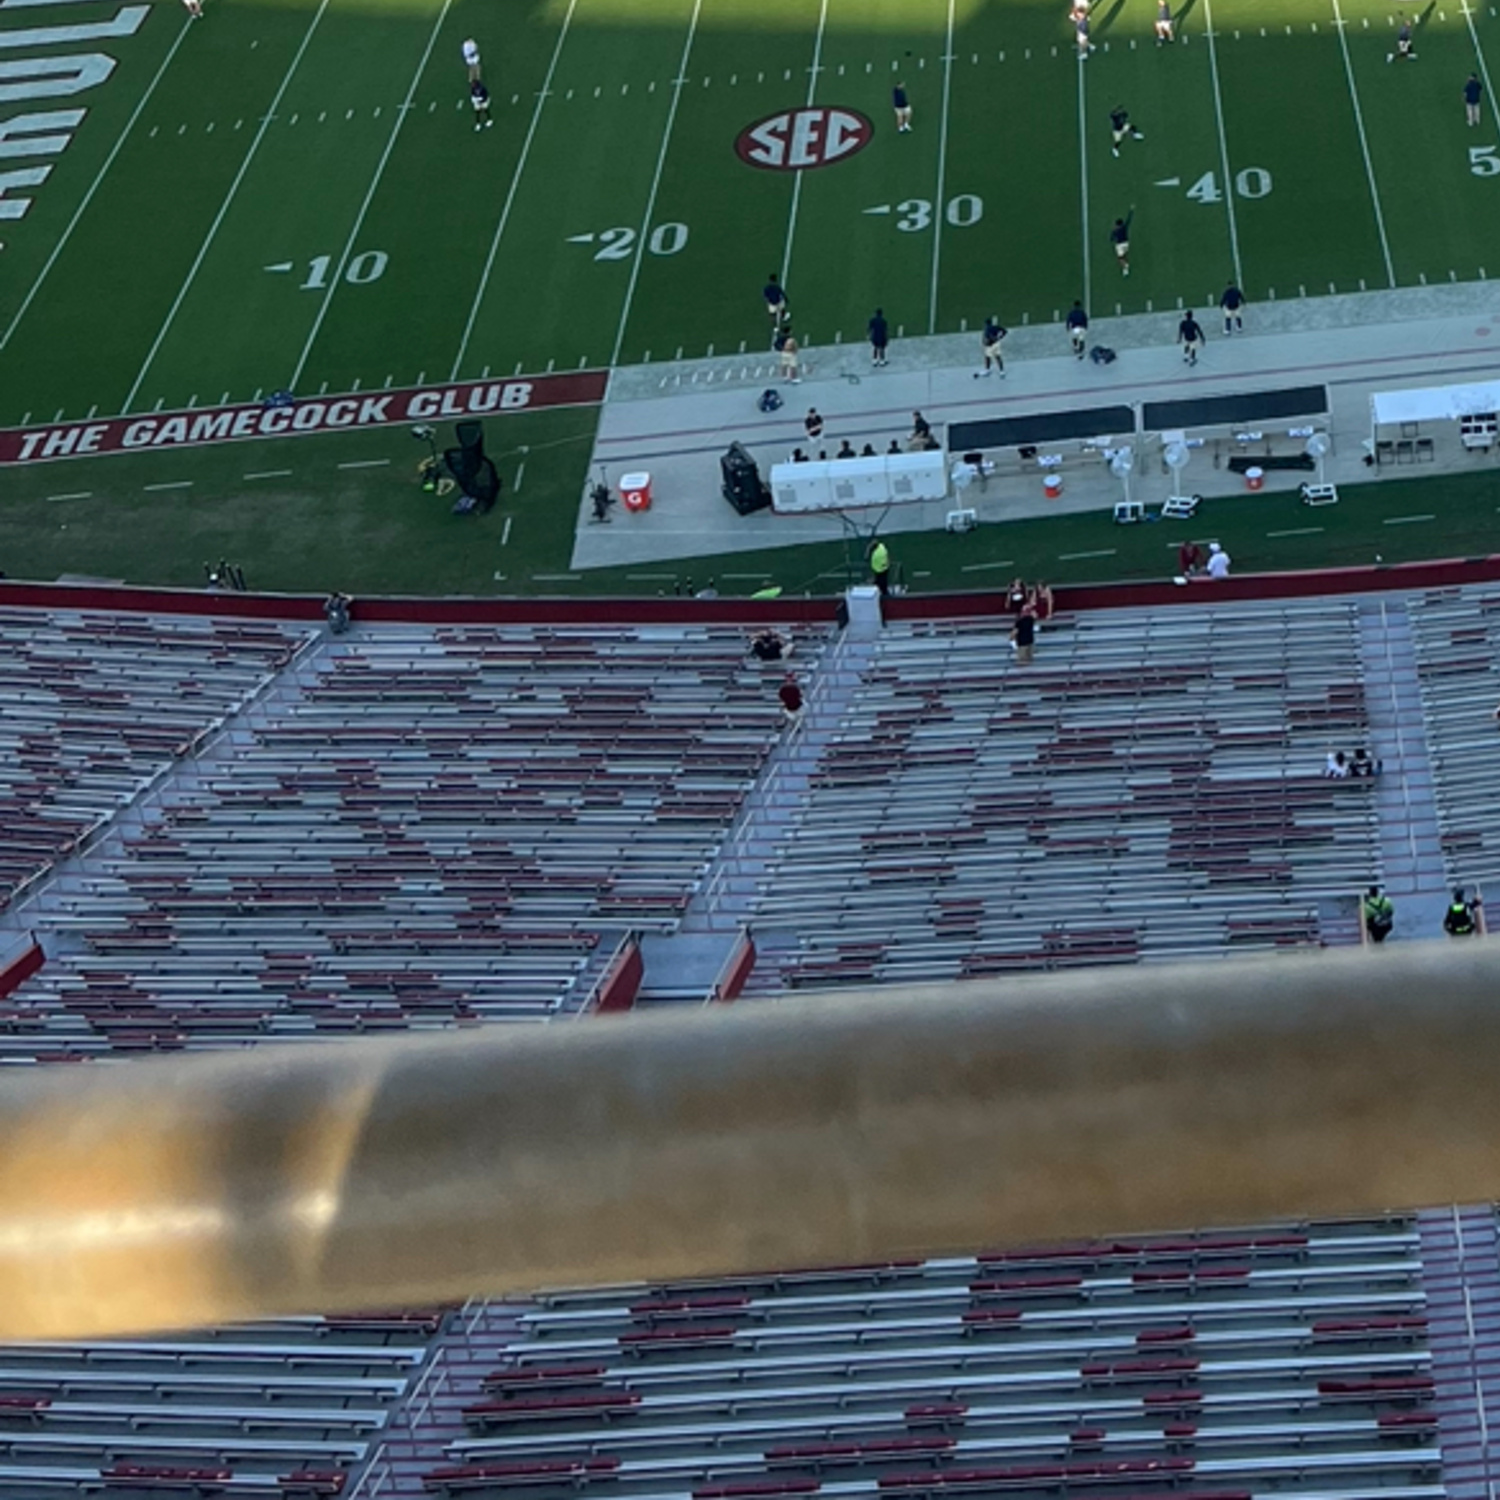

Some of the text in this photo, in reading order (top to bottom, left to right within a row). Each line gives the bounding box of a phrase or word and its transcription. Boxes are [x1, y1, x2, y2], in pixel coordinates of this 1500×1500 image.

[747, 109, 863, 167] SEC
[1186, 167, 1273, 203] 40
[896, 192, 984, 232] 30
[594, 223, 690, 260] 20
[299, 251, 389, 290] 10
[17, 382, 533, 461] THE GAMECOCK CLUB
